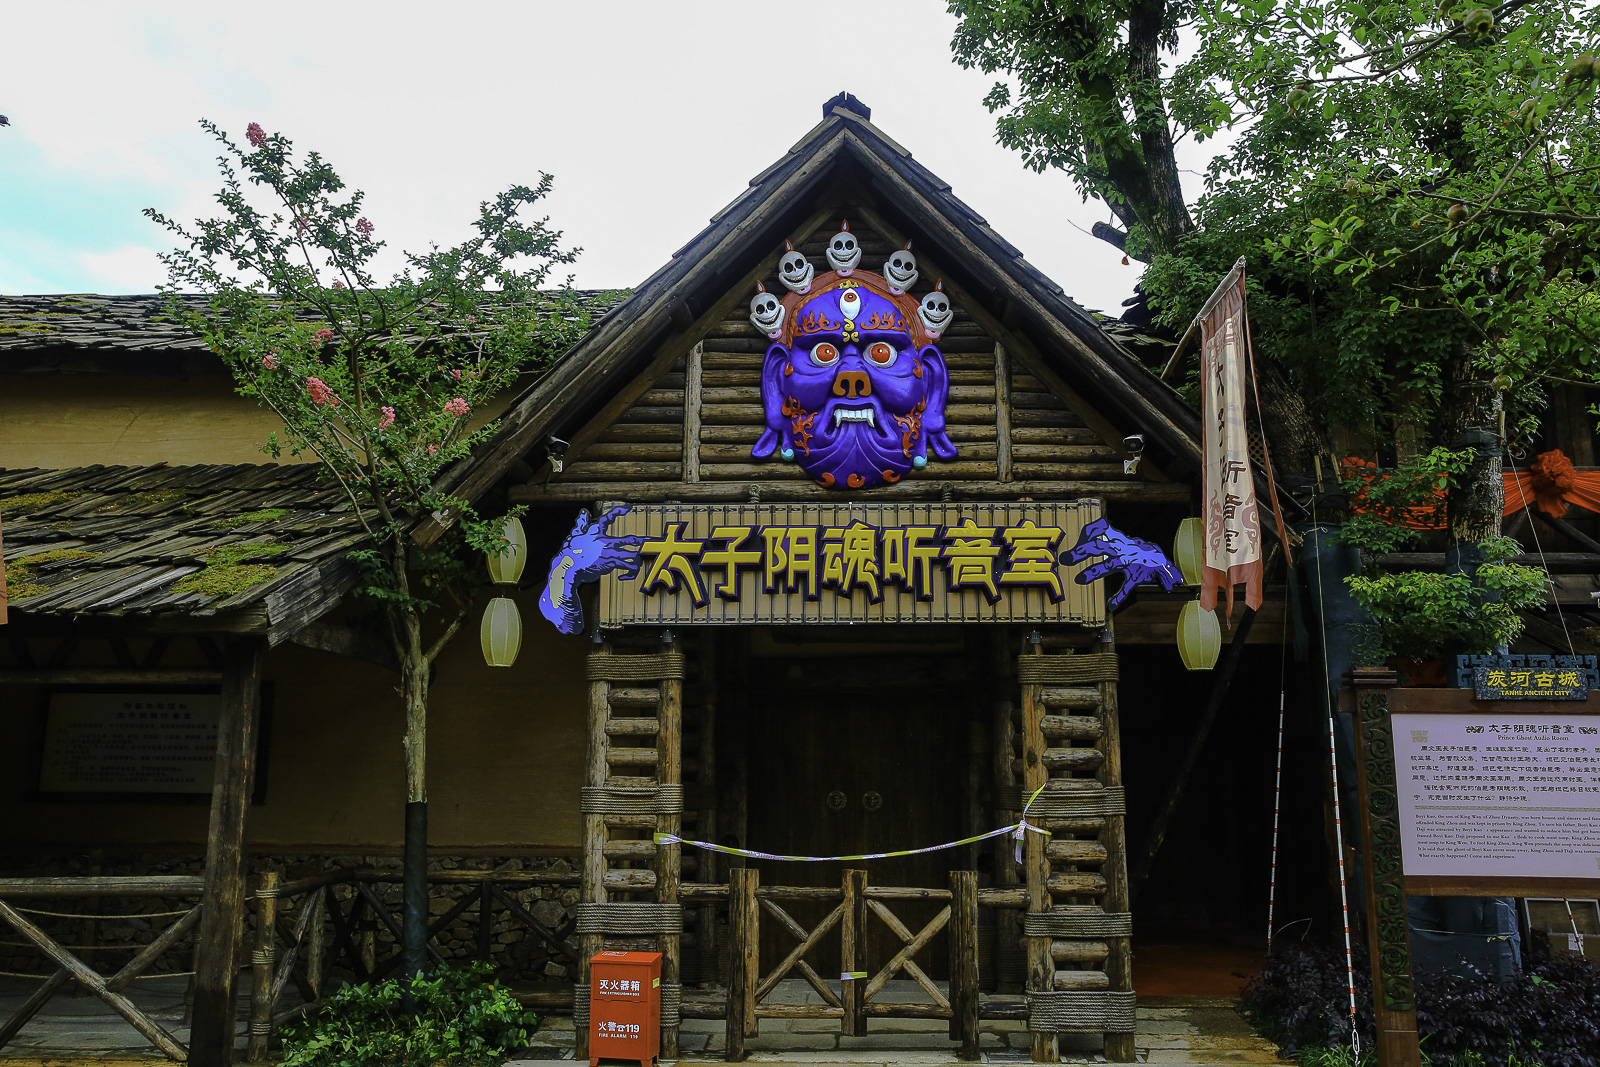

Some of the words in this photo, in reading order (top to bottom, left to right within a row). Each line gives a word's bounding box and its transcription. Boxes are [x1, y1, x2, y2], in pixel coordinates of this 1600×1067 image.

[640, 518, 1065, 606] 太子阴魂听音室
[1487, 670, 1580, 687] 炭河古城
[1488, 724, 1575, 734] 太子阴魂听音室
[599, 979, 641, 991] 灭火器箱
